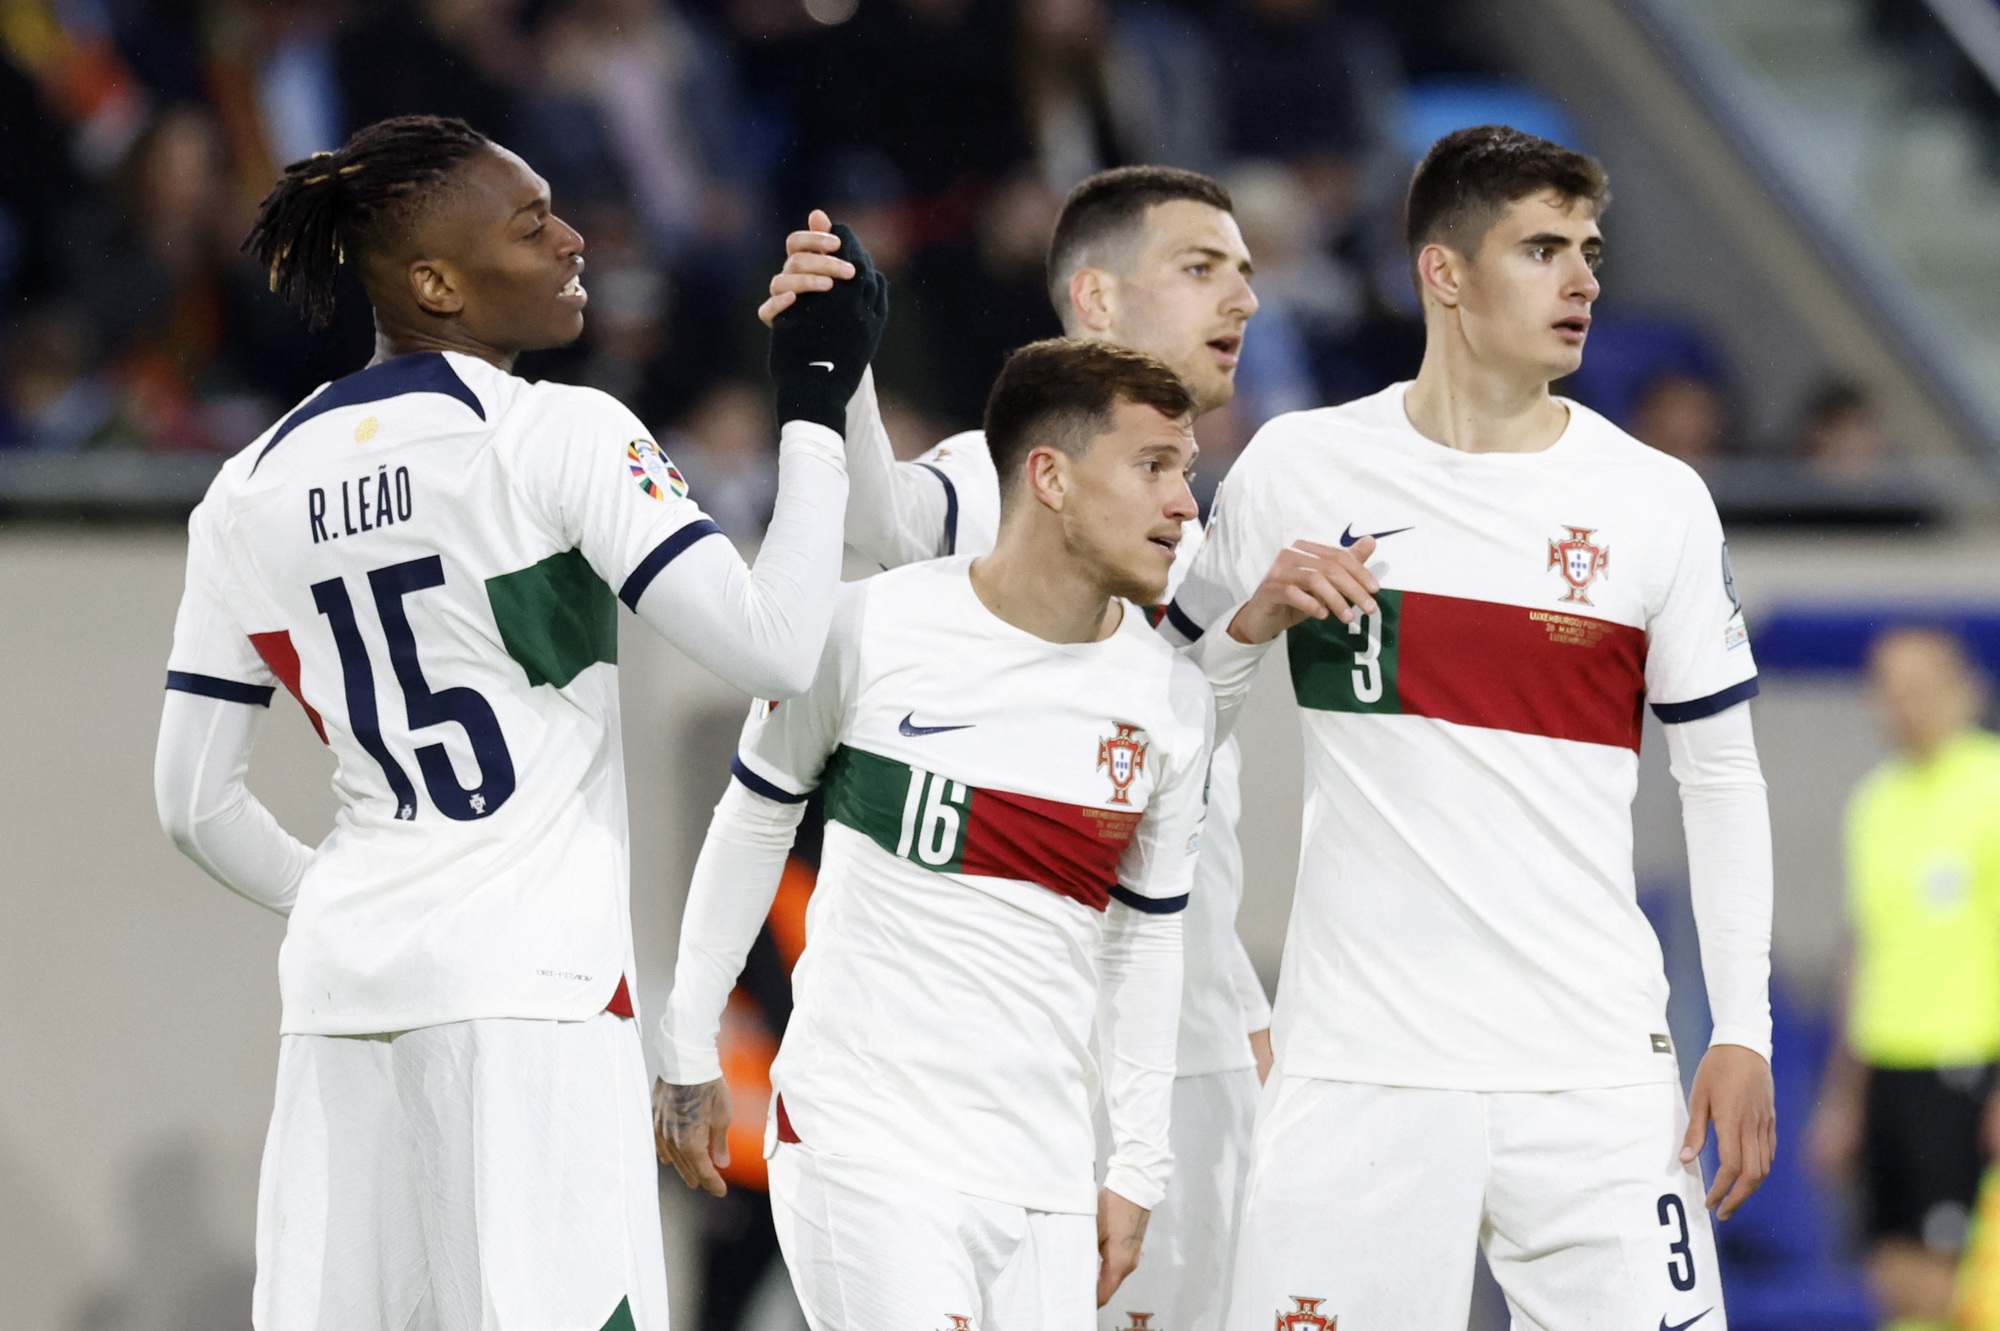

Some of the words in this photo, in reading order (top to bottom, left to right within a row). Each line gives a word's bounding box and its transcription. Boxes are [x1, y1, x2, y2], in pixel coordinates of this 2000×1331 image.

[310, 554, 516, 821] 15
[1348, 603, 1383, 703] 3
[896, 764, 967, 866] 16
[1657, 1193, 1696, 1292] 3
